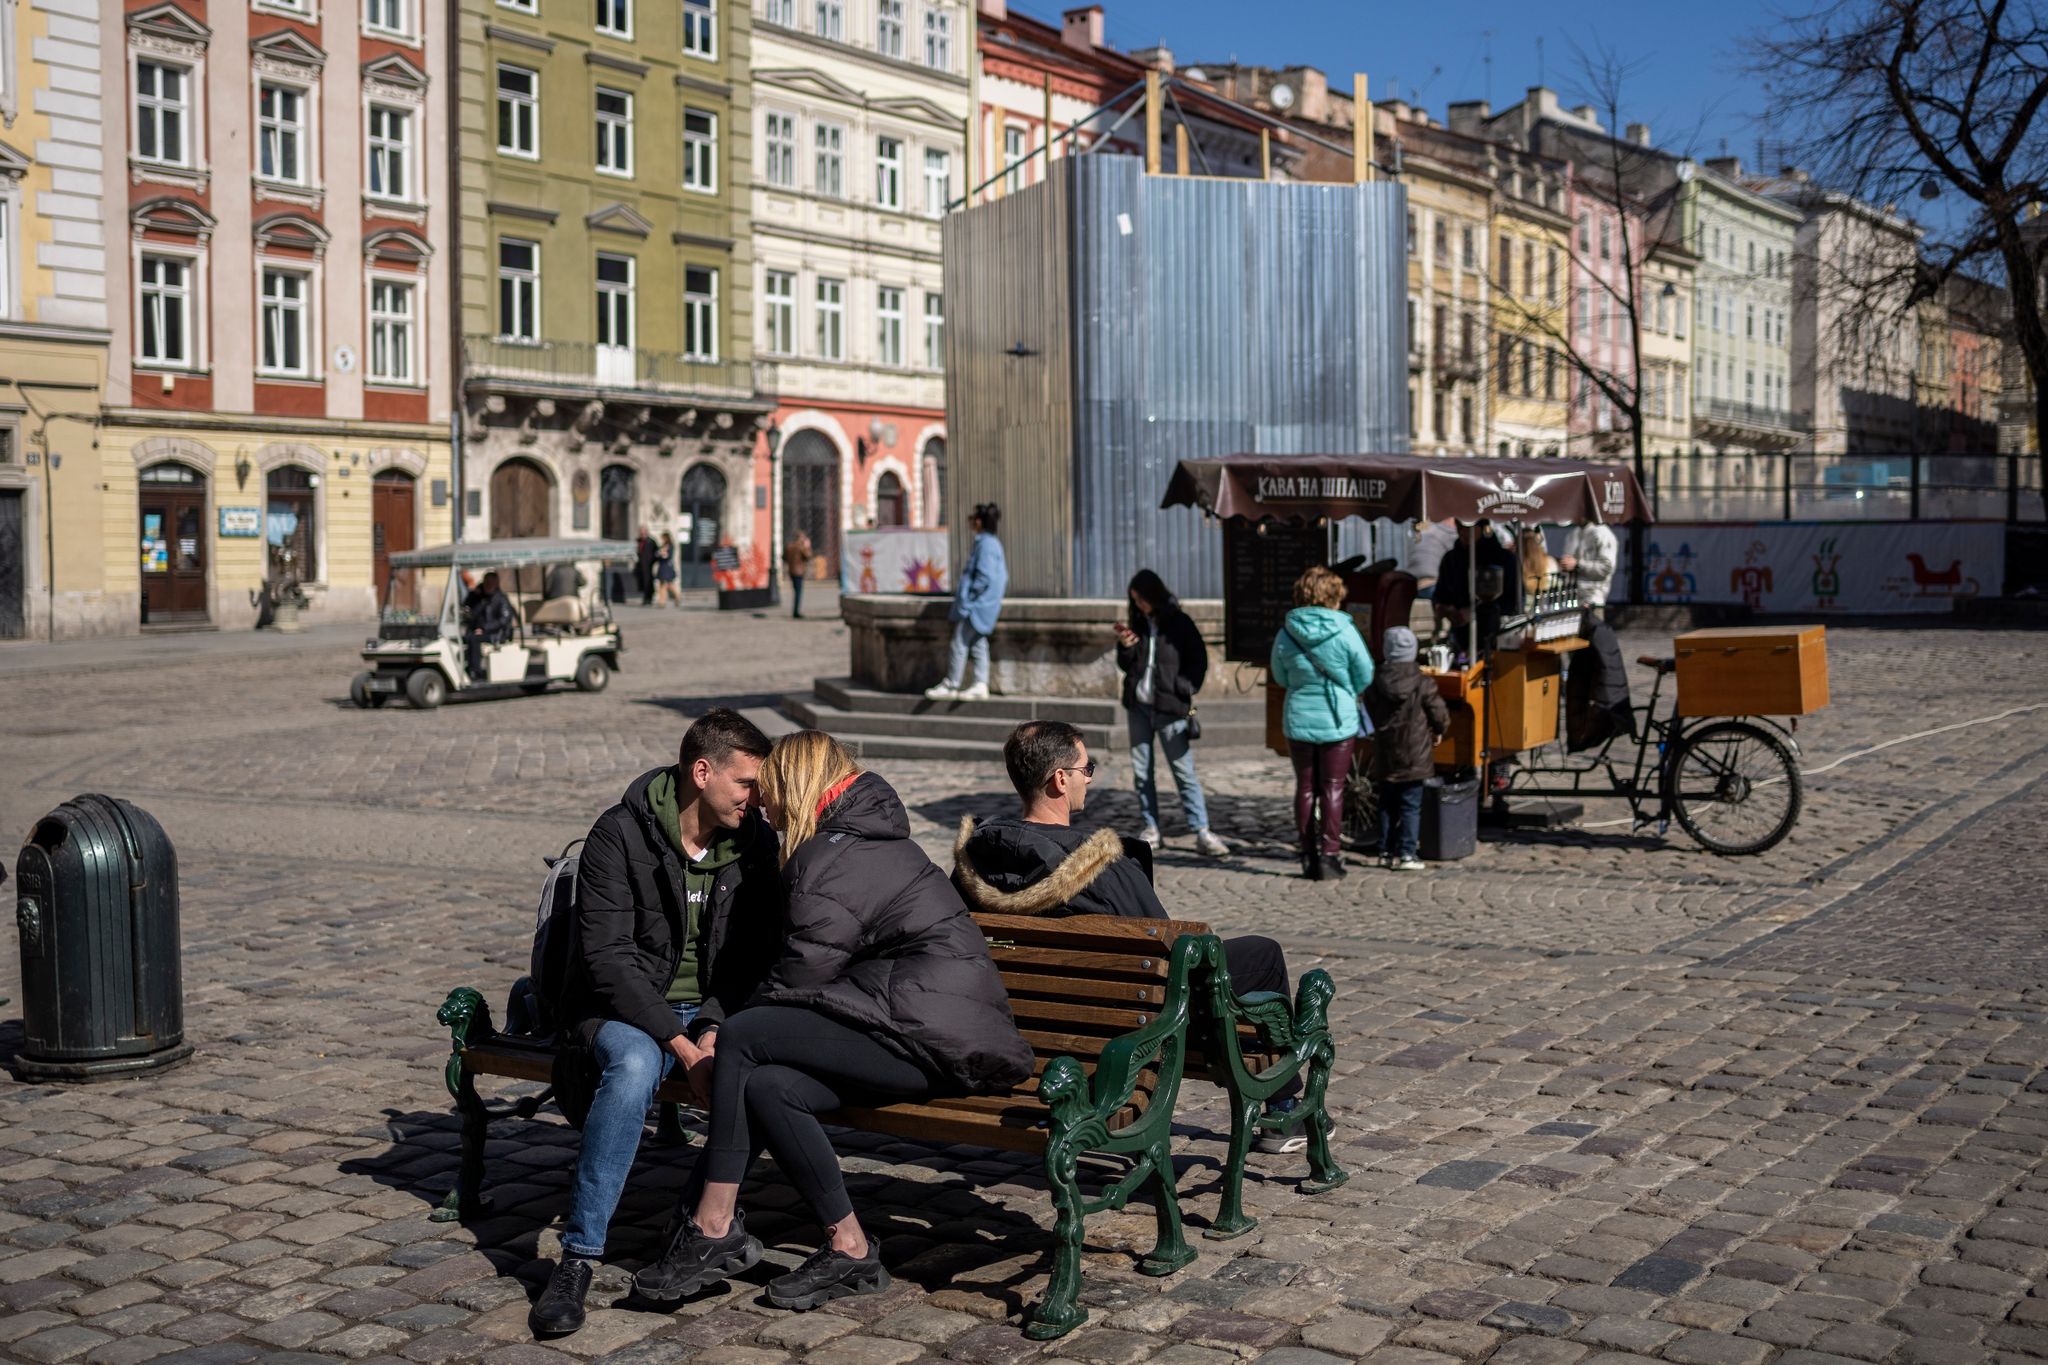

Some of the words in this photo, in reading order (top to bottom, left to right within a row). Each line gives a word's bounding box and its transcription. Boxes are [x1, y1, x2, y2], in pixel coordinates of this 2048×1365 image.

[1254, 476, 1296, 502] КАВА
[1298, 476, 1319, 497] НА
[1321, 477, 1387, 501] ШПАЦЕР
